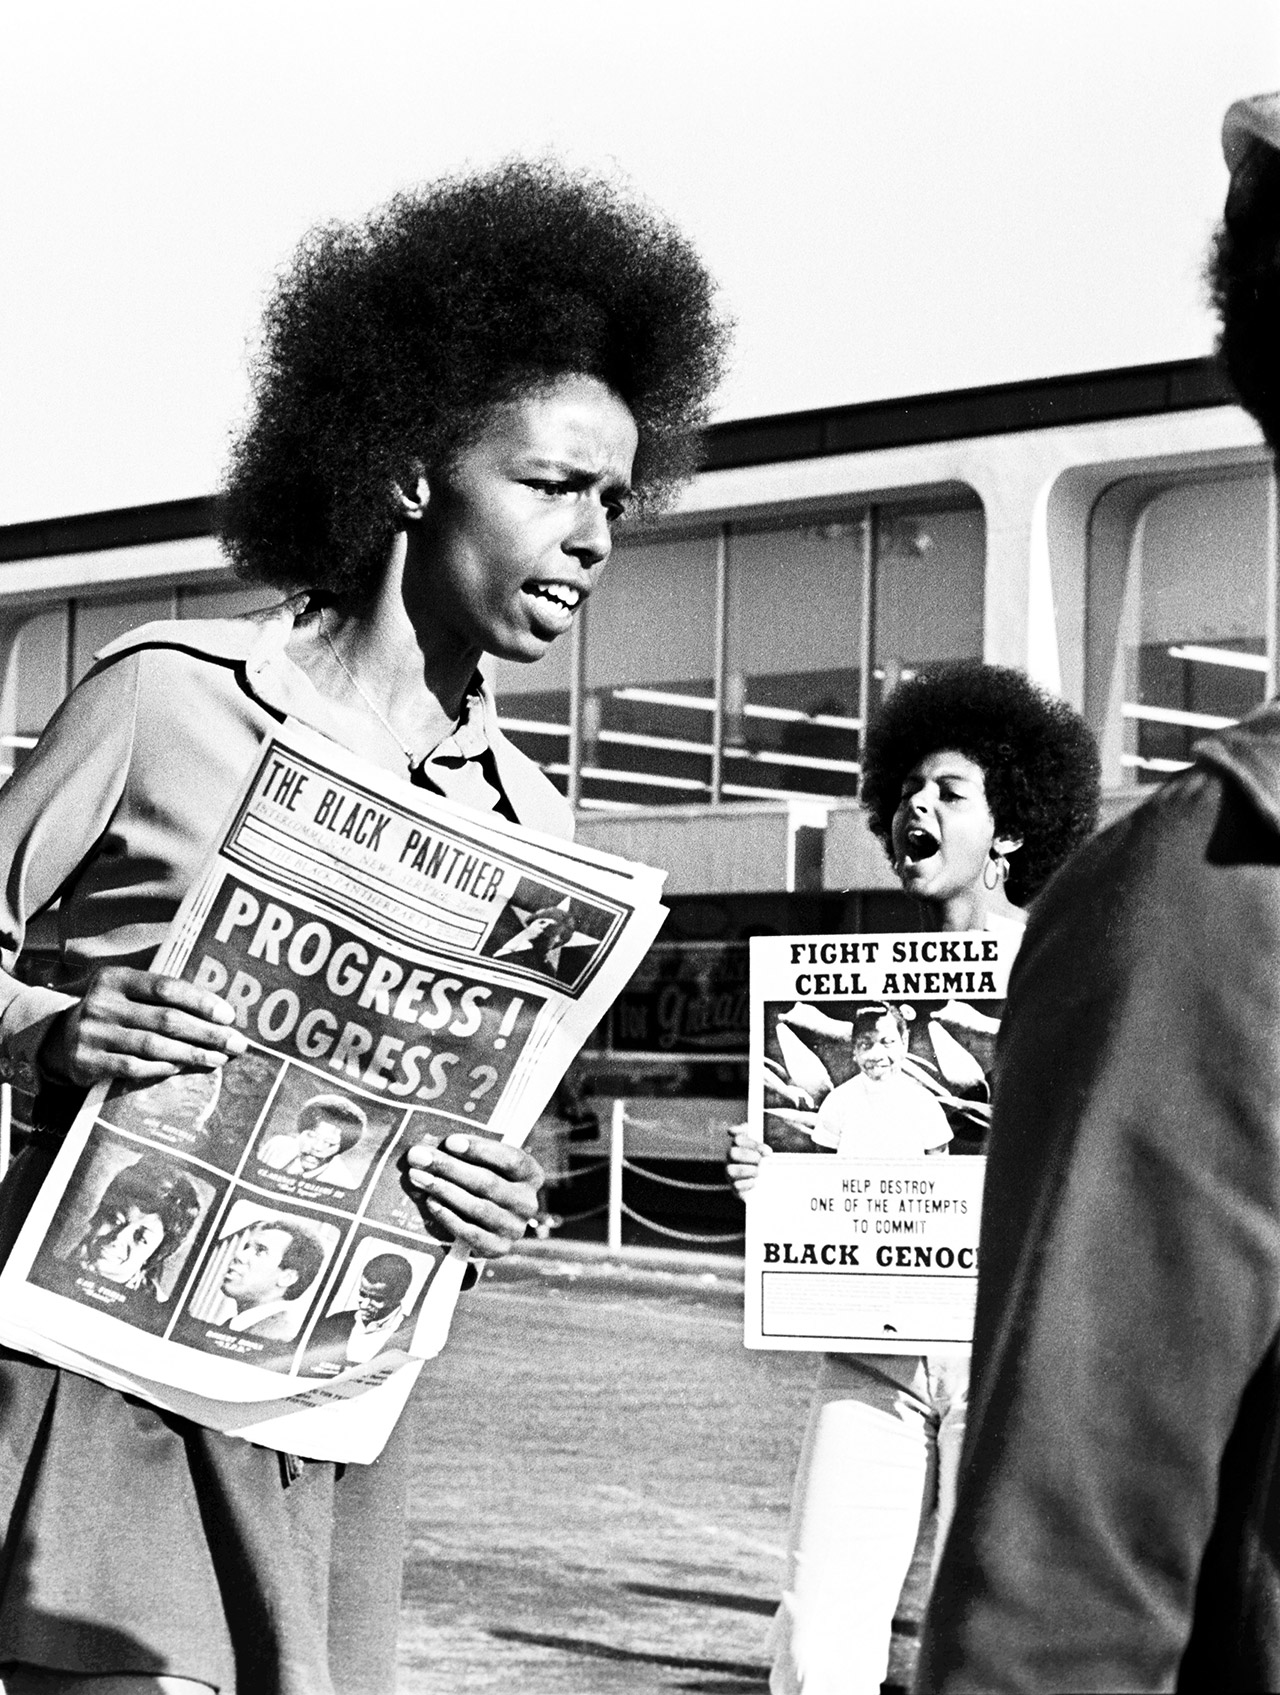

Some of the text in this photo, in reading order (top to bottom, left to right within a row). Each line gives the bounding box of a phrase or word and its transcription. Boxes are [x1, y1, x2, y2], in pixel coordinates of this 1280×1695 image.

[262, 761, 309, 811] THE
[314, 789, 391, 852] BLACK
[399, 829, 505, 903] PANTHER
[790, 940, 999, 965] FIGHT SICKLE
[795, 971, 997, 995] CELL ANEMIA
[842, 1179, 936, 1195] HELP DESTROY
[810, 1198, 968, 1214] ONE OF THE ATTEMPTS
[852, 1219, 927, 1234] TO COMMIT
[763, 1243, 980, 1270] BLACK GENOC
